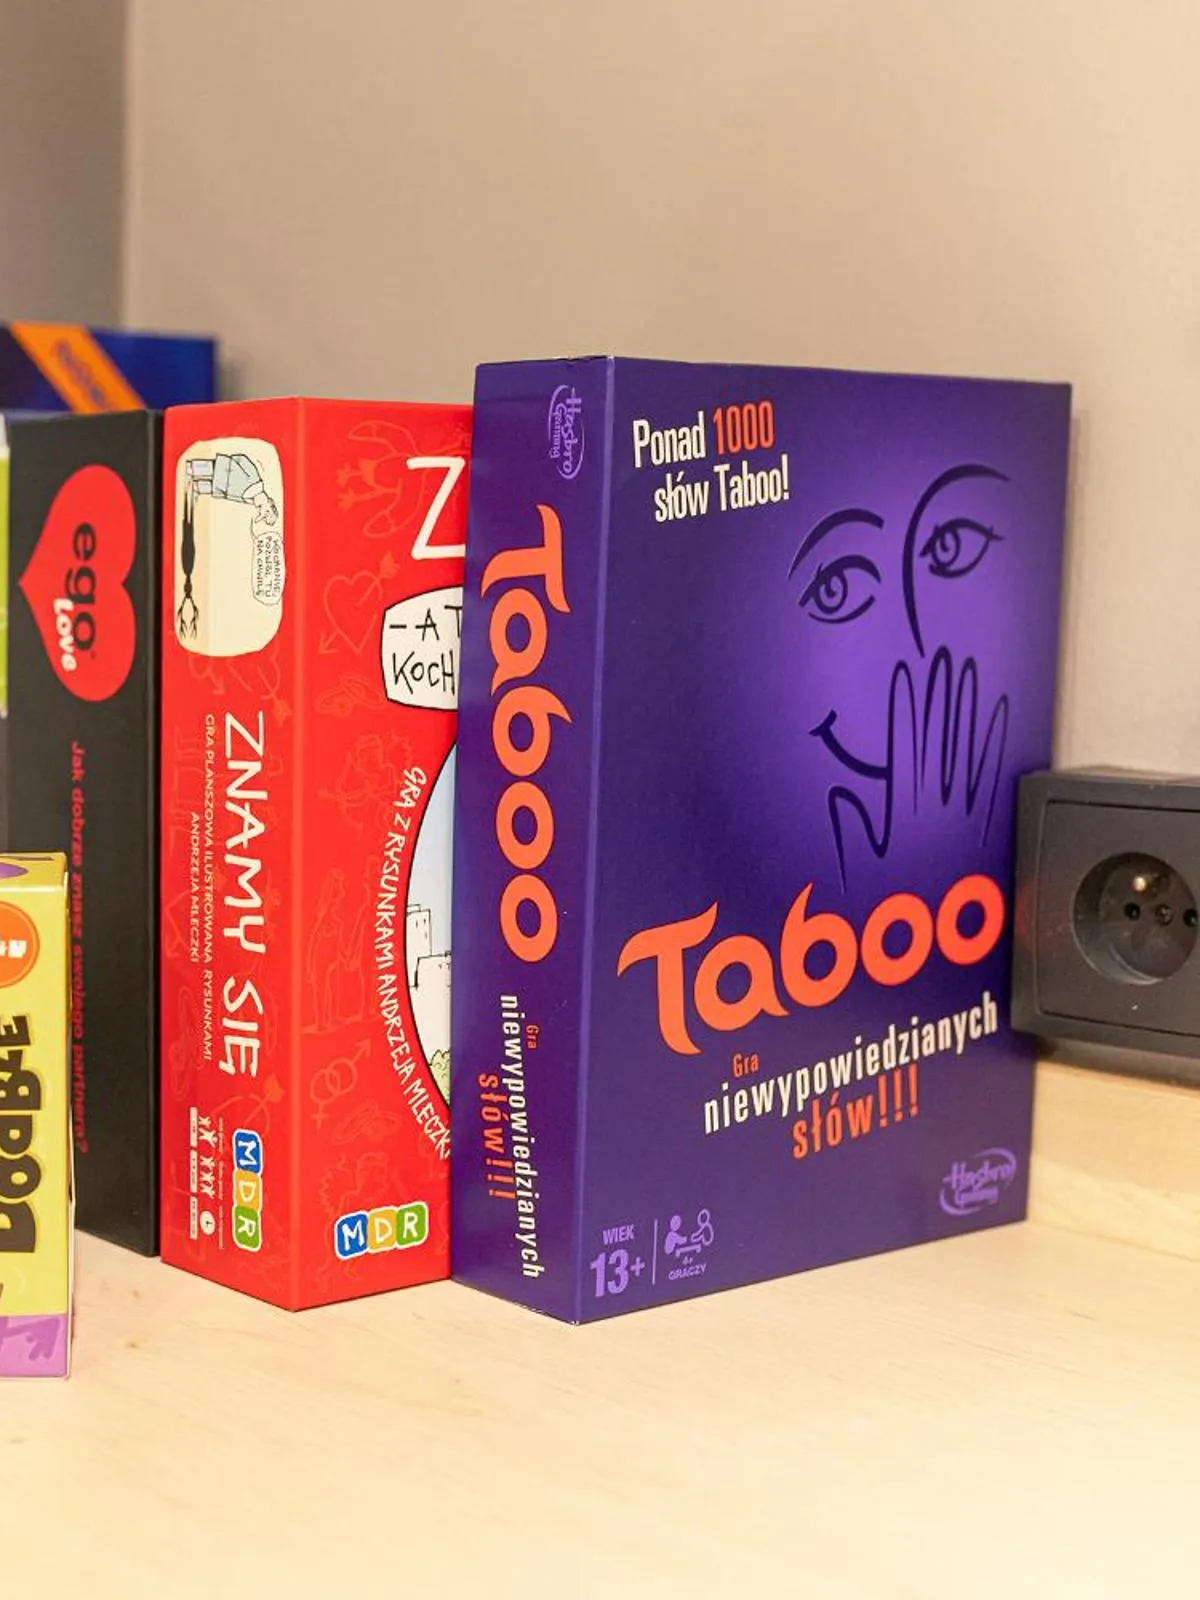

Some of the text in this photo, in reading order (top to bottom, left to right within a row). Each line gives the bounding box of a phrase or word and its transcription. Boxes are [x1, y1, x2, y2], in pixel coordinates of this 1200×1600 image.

[562, 387, 582, 474] Hasbro
[632, 400, 775, 468] Ponad 1000
[654, 454, 790, 523] słów Taboo!
[65, 522, 97, 651] ego
[71, 741, 86, 781] Jak
[481, 503, 573, 963] Taboo
[71, 787, 85, 867] dobrze
[393, 765, 428, 808] GRA
[394, 813, 412, 832] Z
[188, 811, 200, 964] ANDRZEJA MLECZKI
[201, 714, 215, 1062] GRA PLANSZOWA ILUSTROWANA RYSUNKAMI
[219, 710, 268, 1078] ZNAMY SIĘ
[373, 831, 406, 970] RYSUNKAMI
[617, 874, 1006, 1055] Taboo
[377, 975, 417, 1085] ANDRZEJA
[526, 1023, 540, 1050] Gra
[705, 991, 998, 1136] niewypowiedzianych
[732, 1052, 760, 1079] Gra
[478, 1072, 517, 1201] słów!!!
[500, 994, 545, 1279] niewypowiedzianych
[791, 1063, 920, 1160] słów!!!
[237, 1139, 258, 1240] MDR
[341, 1210, 419, 1252] MDR
[602, 1224, 635, 1246] WIEK
[590, 1249, 645, 1298] 13+
[668, 1264, 707, 1281] GRACZY
